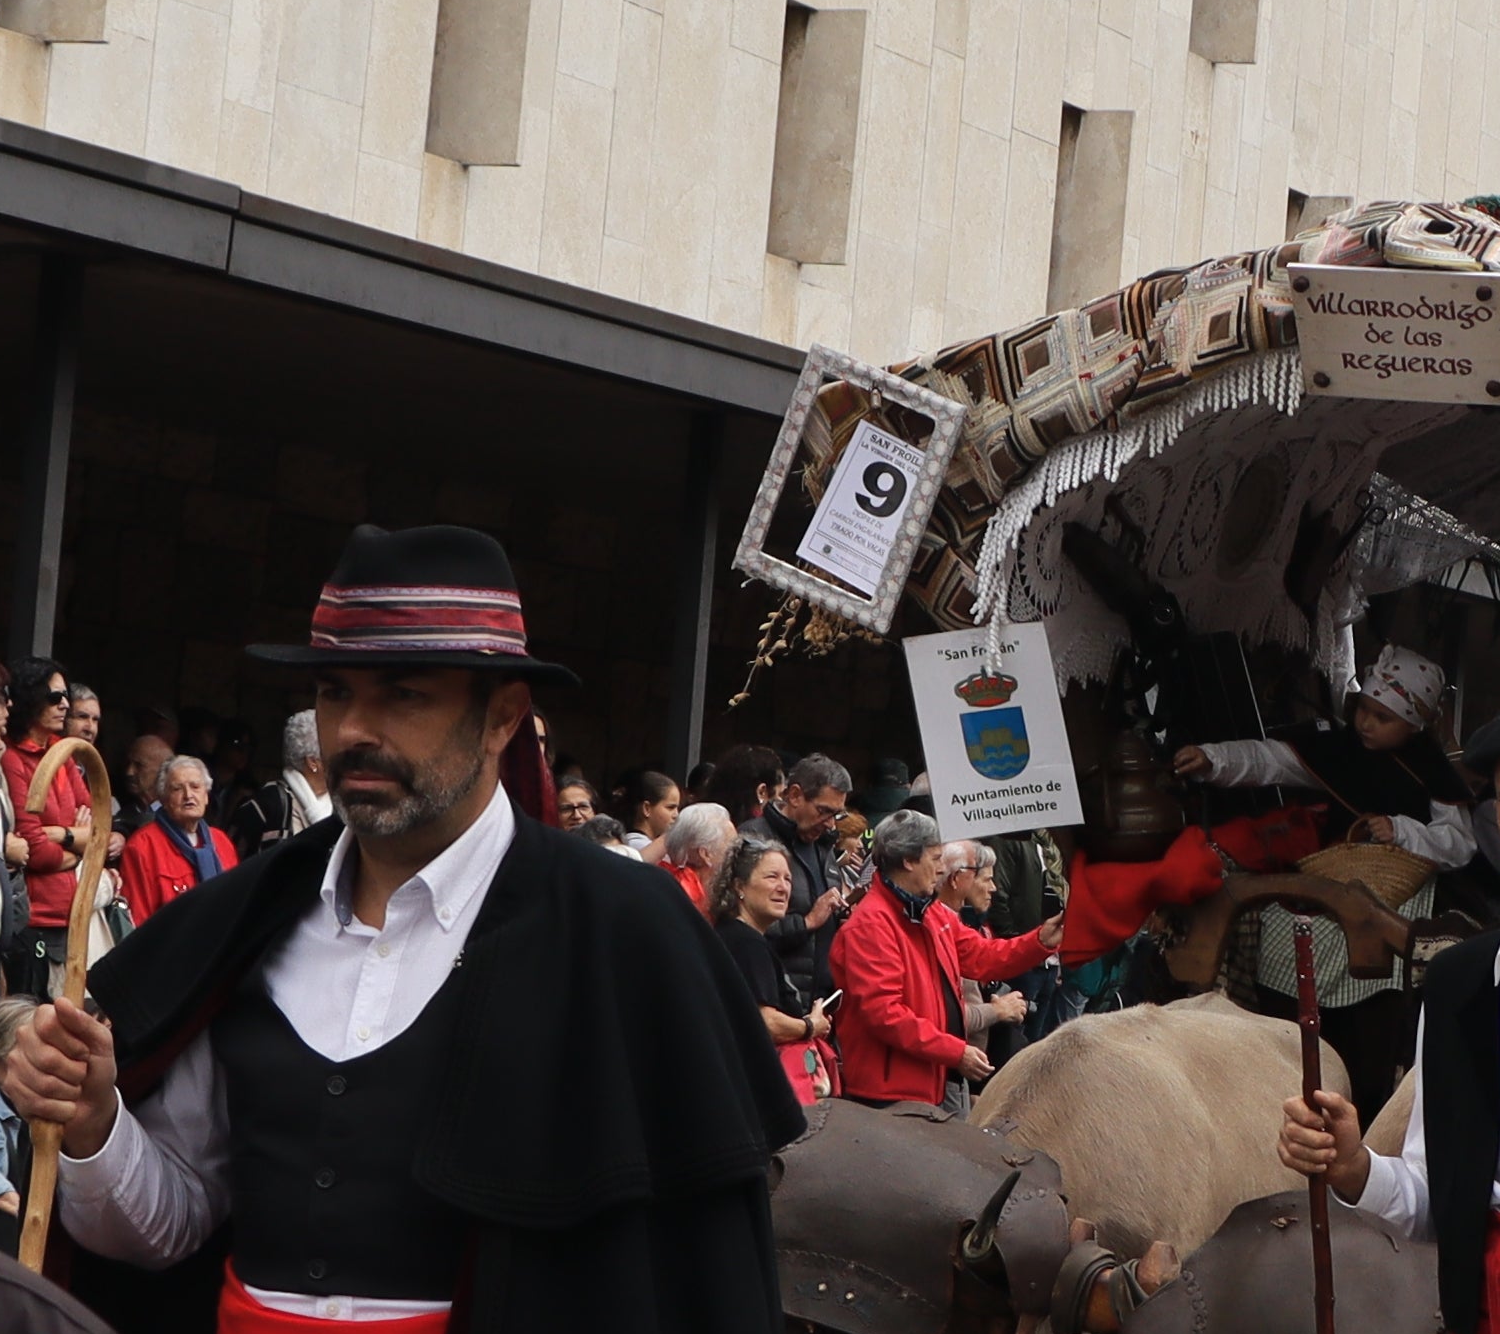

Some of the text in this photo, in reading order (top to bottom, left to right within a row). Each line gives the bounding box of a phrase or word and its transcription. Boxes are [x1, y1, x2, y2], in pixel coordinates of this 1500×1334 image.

[1364, 323, 1443, 347] de las
[870, 433, 923, 467] SAN FROIL
[855, 461, 907, 518] 9
[971, 640, 1020, 658] Frán"
[951, 779, 1062, 806] Ayuntamiento de
[963, 799, 1058, 822] Villaquilambre
